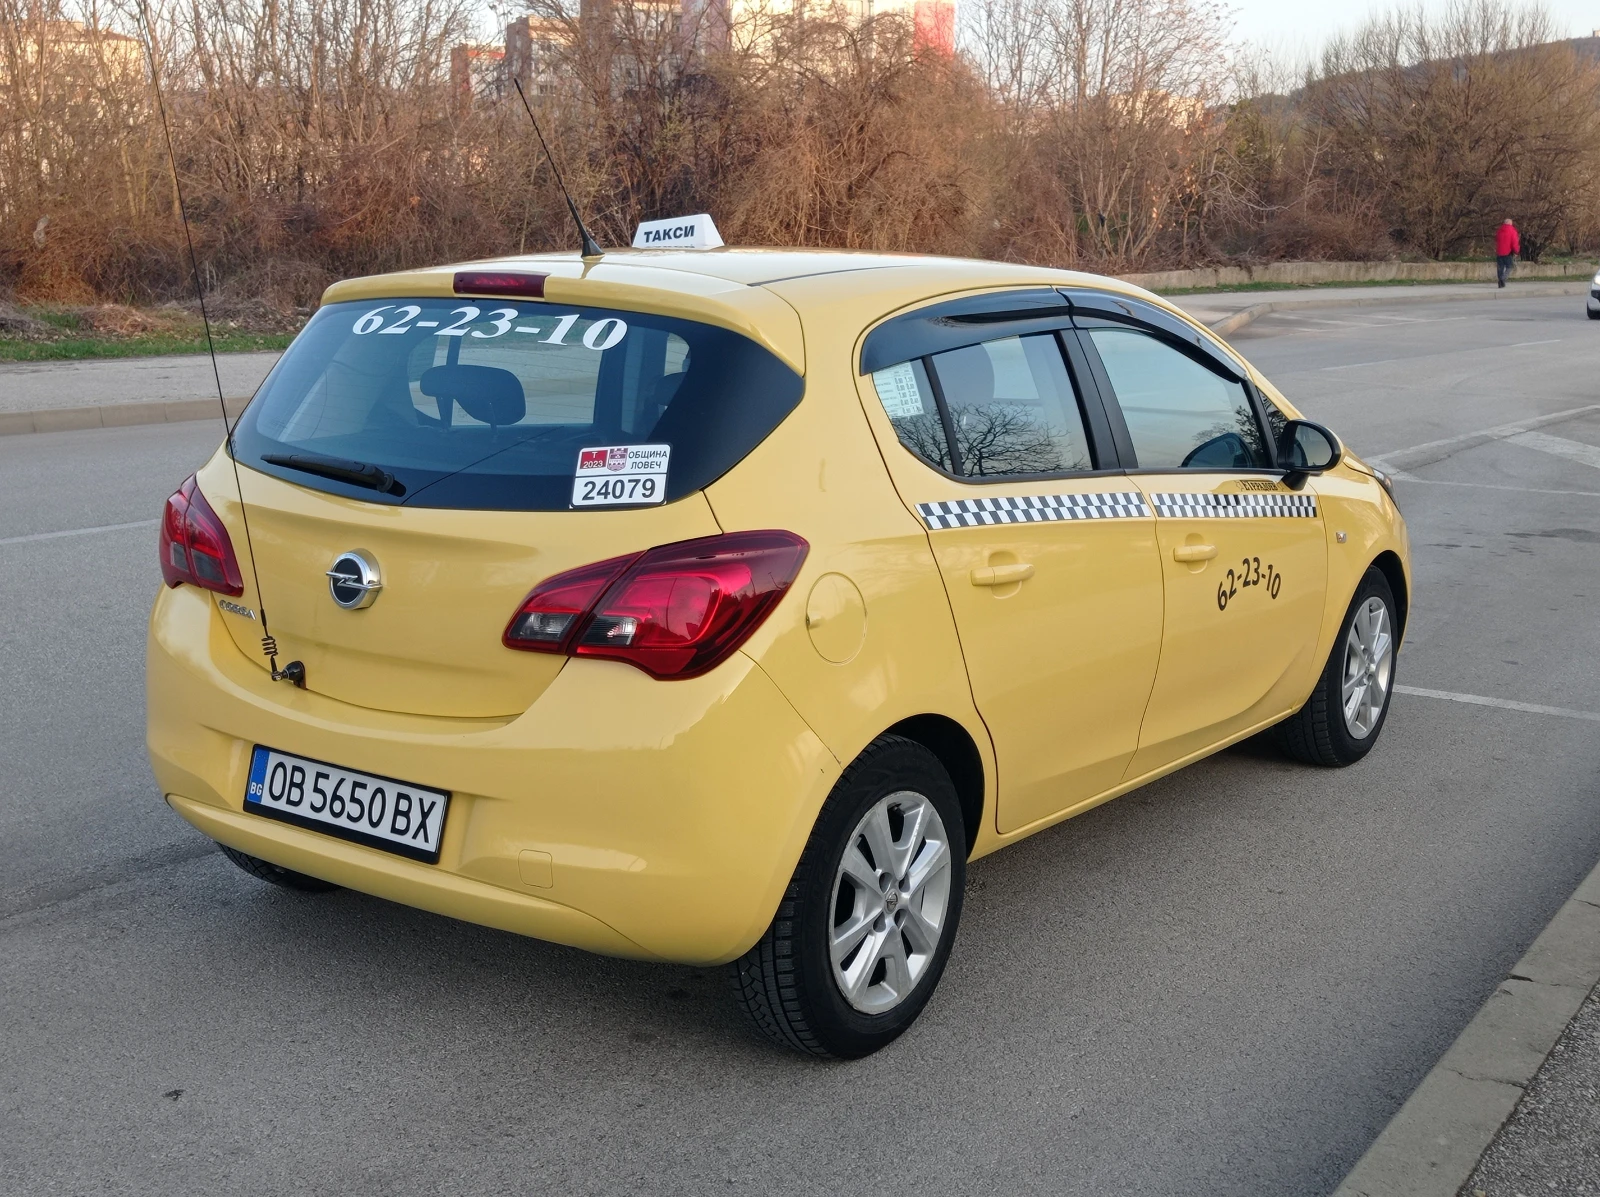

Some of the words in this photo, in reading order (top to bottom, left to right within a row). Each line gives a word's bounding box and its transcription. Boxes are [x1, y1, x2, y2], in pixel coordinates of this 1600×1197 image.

[644, 225, 695, 243] ТАКСИ
[352, 305, 628, 350] 62-23-10
[628, 450, 668, 459] ОБЩИНА
[583, 460, 603, 469] 2023
[630, 461, 662, 469] ЛОВЕЧ
[581, 478, 656, 501] 24079
[1217, 556, 1281, 611] 62-23-10
[250, 782, 263, 796] BG
